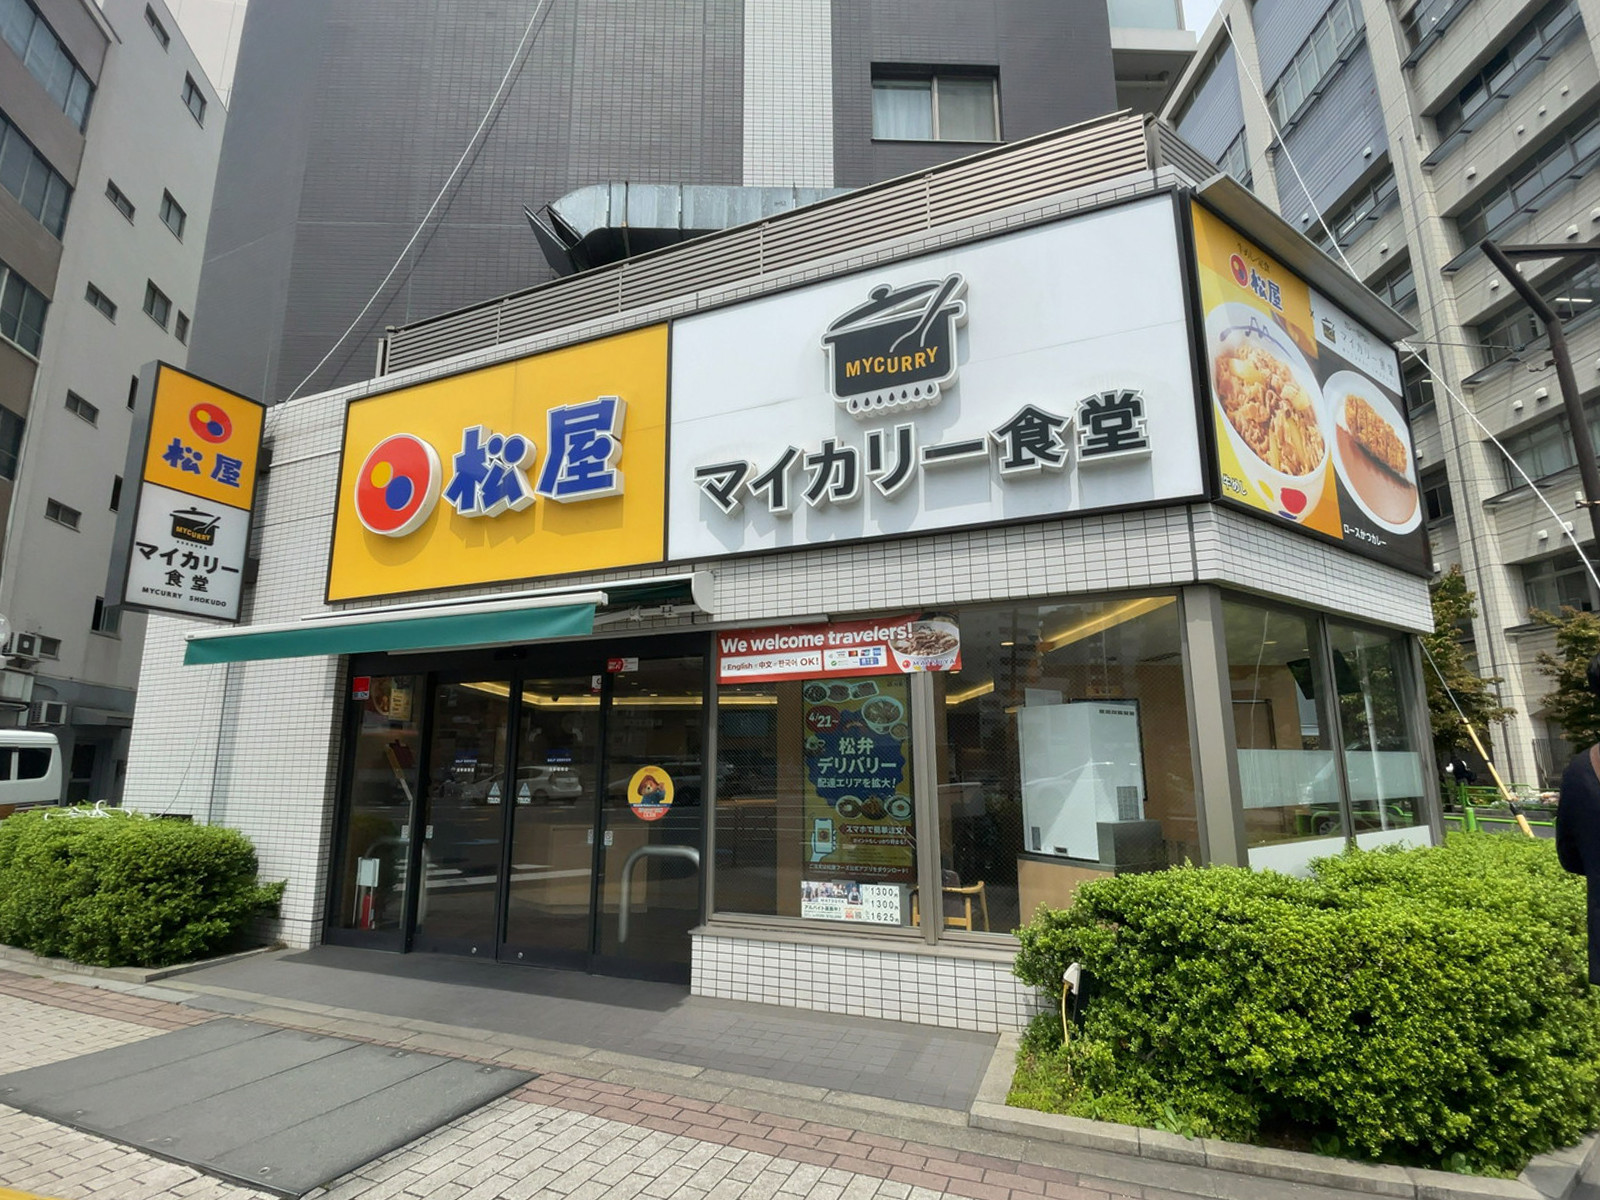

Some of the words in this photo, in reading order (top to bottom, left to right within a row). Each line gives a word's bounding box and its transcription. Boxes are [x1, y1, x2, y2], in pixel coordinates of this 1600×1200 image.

[1250, 268, 1283, 312] 松屋
[845, 345, 938, 378] MYCURRY
[162, 438, 243, 488] 松屋
[442, 396, 627, 518] 松屋
[694, 388, 1153, 516] マイカリー食堂
[175, 525, 211, 541] MYCURRY
[1343, 523, 1387, 546] ロースかつカレー
[135, 541, 240, 574] マイカリー
[165, 569, 209, 593] 食堂
[141, 586, 183, 599] MYCURRY
[189, 595, 227, 607] SHOKUDO
[720, 637, 748, 654] We
[750, 632, 824, 651] welcome
[828, 621, 913, 646] travelers!
[727, 662, 753, 671] English
[758, 660, 773, 669] 中文
[800, 657, 819, 666] OK!
[839, 737, 874, 755] 松弁
[817, 757, 897, 775] デリバリー
